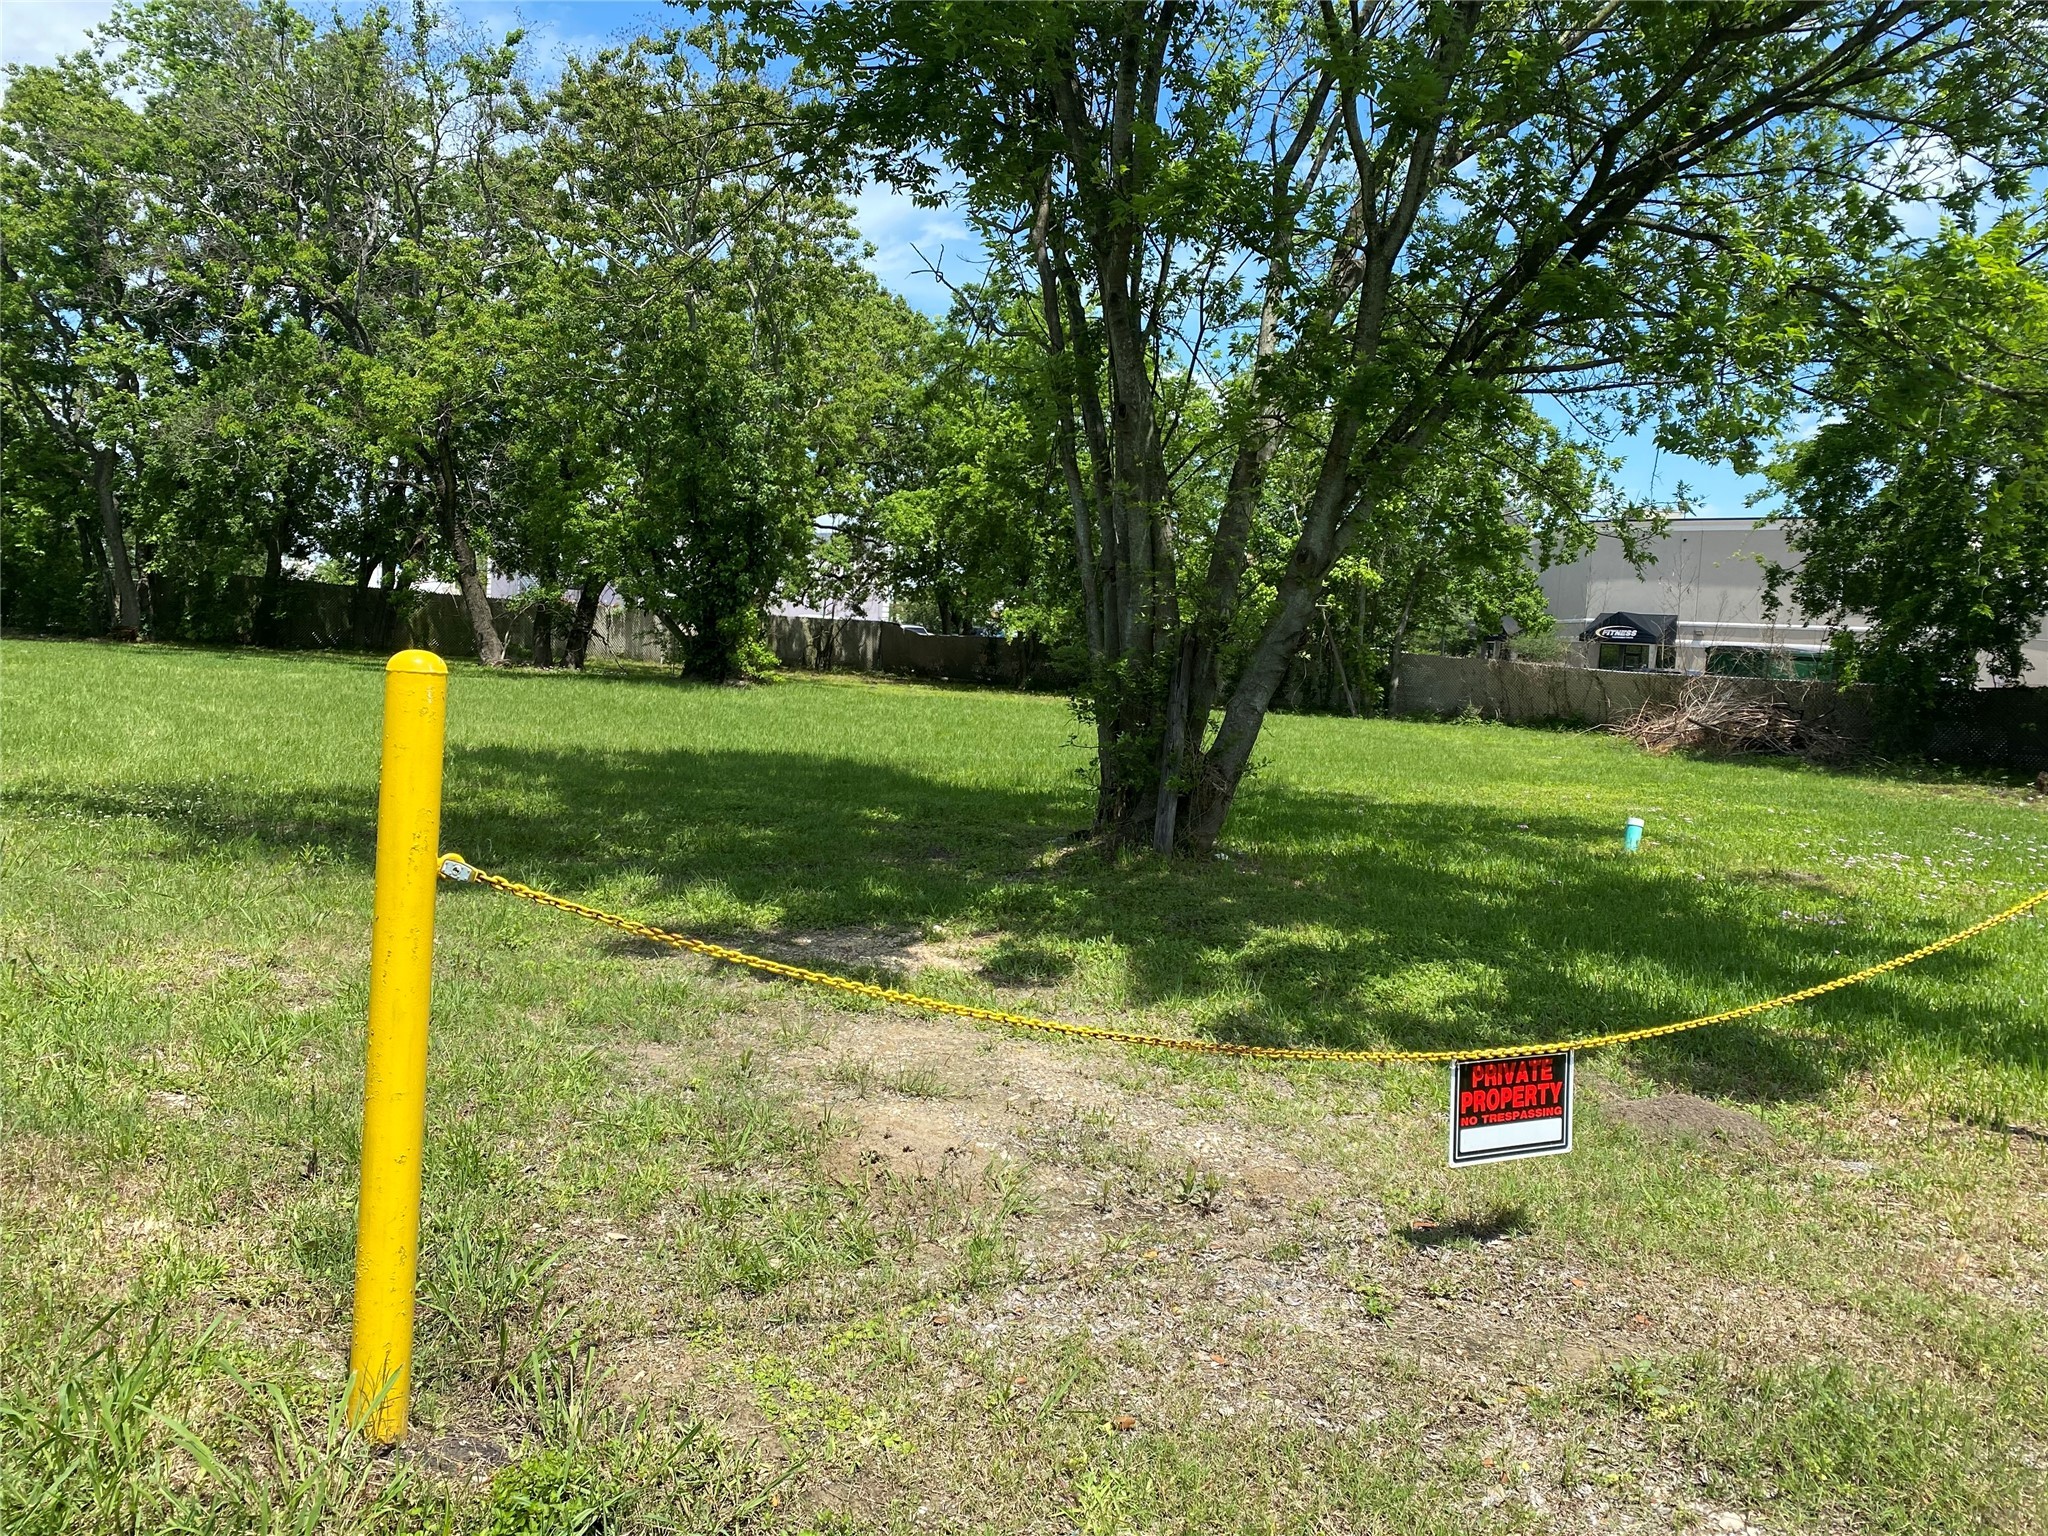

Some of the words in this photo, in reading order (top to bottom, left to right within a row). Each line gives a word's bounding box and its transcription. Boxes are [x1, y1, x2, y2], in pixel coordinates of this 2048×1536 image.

[1602, 629, 1638, 637] FITNESS
[1472, 1058, 1553, 1088] PRIVATE
[1461, 1081, 1563, 1114] PROPERTY
[1460, 1116, 1478, 1126] NO
[1481, 1106, 1562, 1124] TRESPASSING
